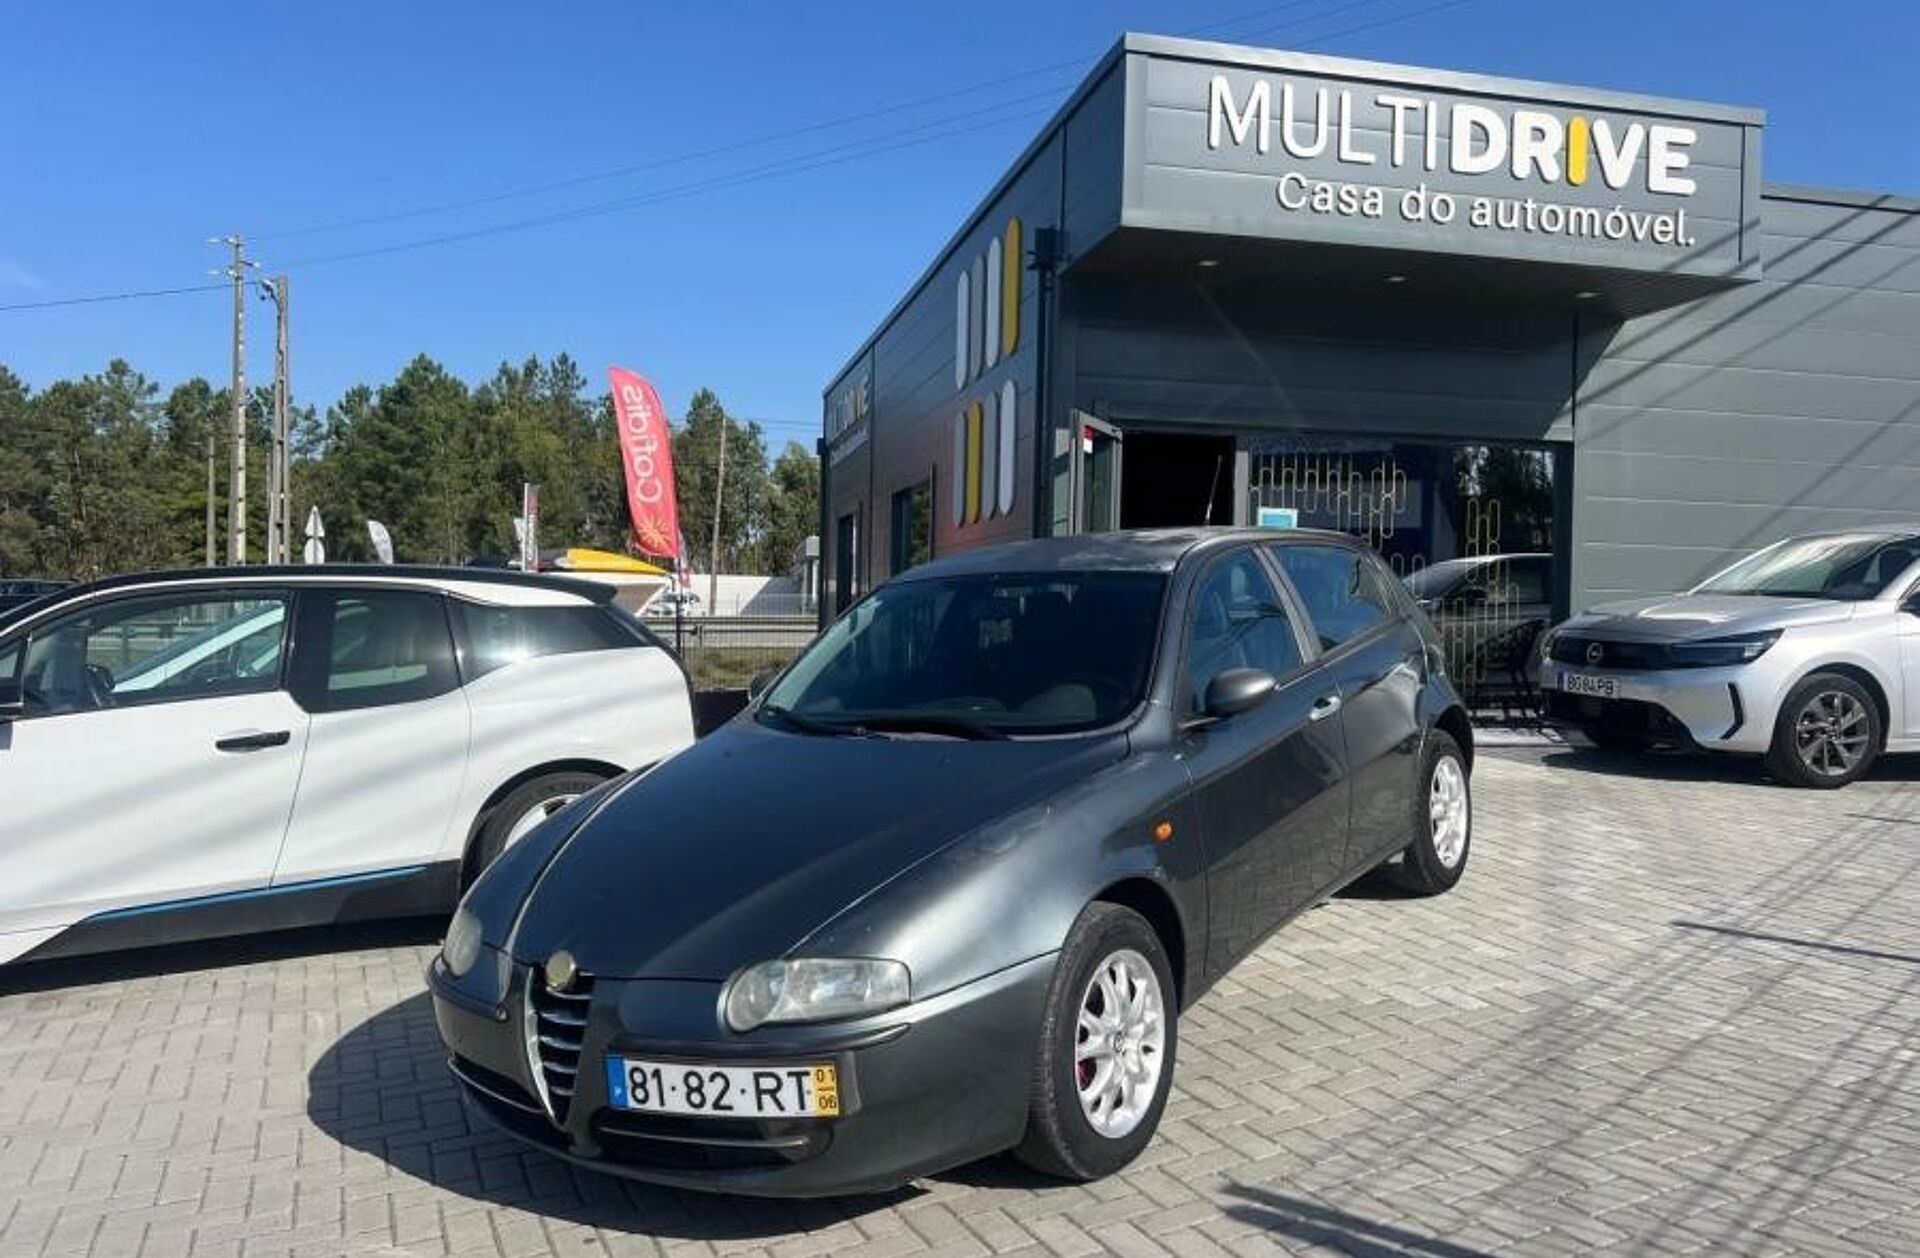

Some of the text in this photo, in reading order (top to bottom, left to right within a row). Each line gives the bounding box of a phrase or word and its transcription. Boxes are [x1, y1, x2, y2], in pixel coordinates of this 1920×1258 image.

[1208, 75, 1697, 195] MULTIDRIVE
[1278, 172, 1696, 246] Casa do automóvel.
